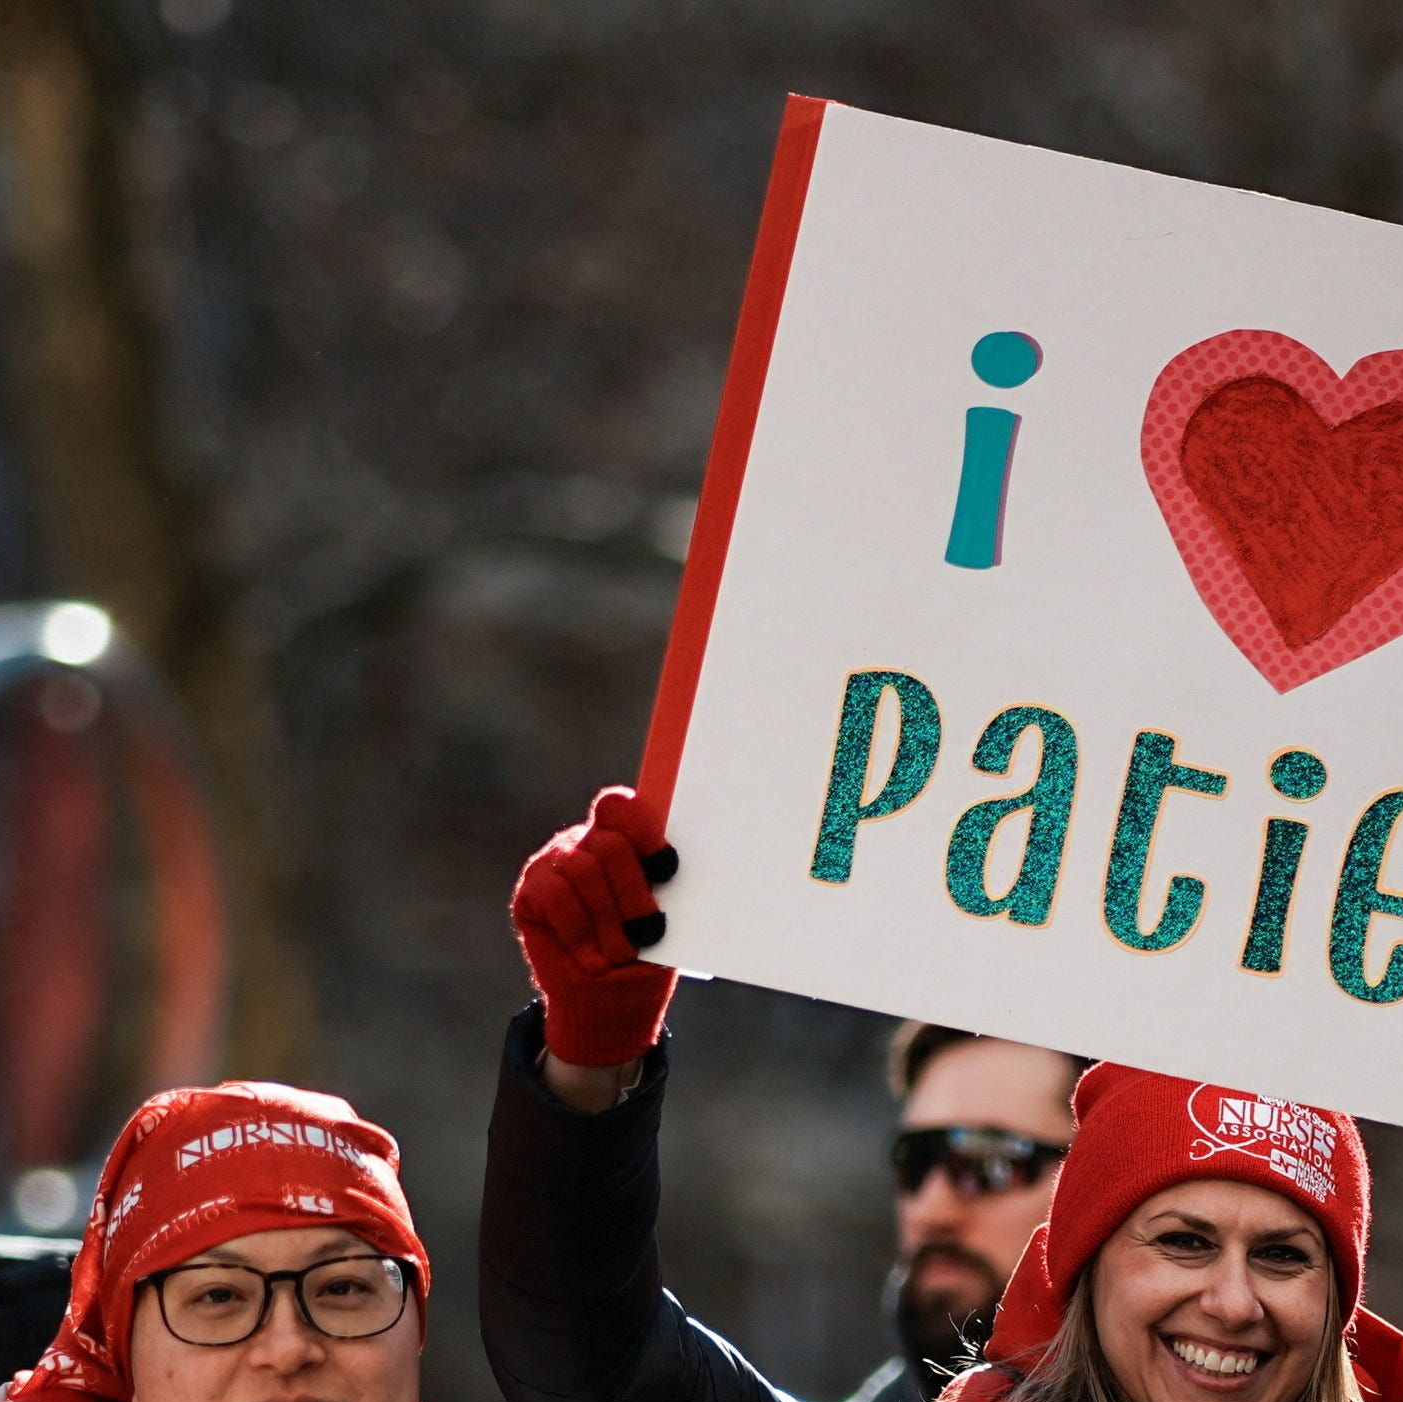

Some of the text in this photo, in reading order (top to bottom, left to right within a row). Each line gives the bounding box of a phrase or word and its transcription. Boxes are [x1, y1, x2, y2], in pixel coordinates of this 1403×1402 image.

[944, 331, 1041, 570] i
[1216, 1122, 1334, 1175] ASSOCIATION
[1218, 1096, 1336, 1159] NURSES
